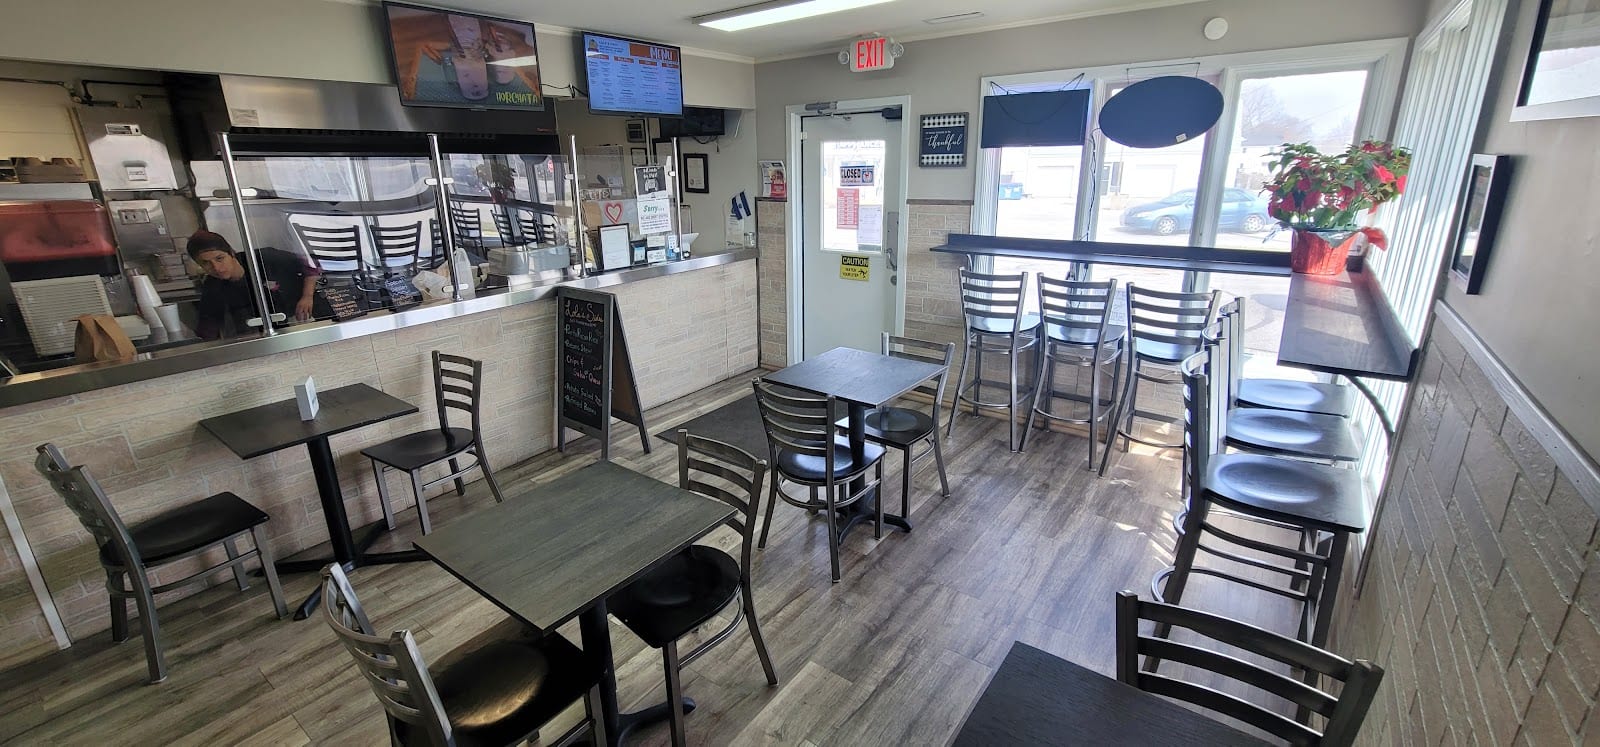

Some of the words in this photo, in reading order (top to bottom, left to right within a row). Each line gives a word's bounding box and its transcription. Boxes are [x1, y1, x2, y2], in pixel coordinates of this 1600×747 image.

[649, 46, 673, 60] MENU
[856, 38, 886, 69] EXIT
[495, 91, 538, 104] HORCHATA
[841, 169, 861, 179] CLOSED
[843, 257, 868, 267] CAUTION
